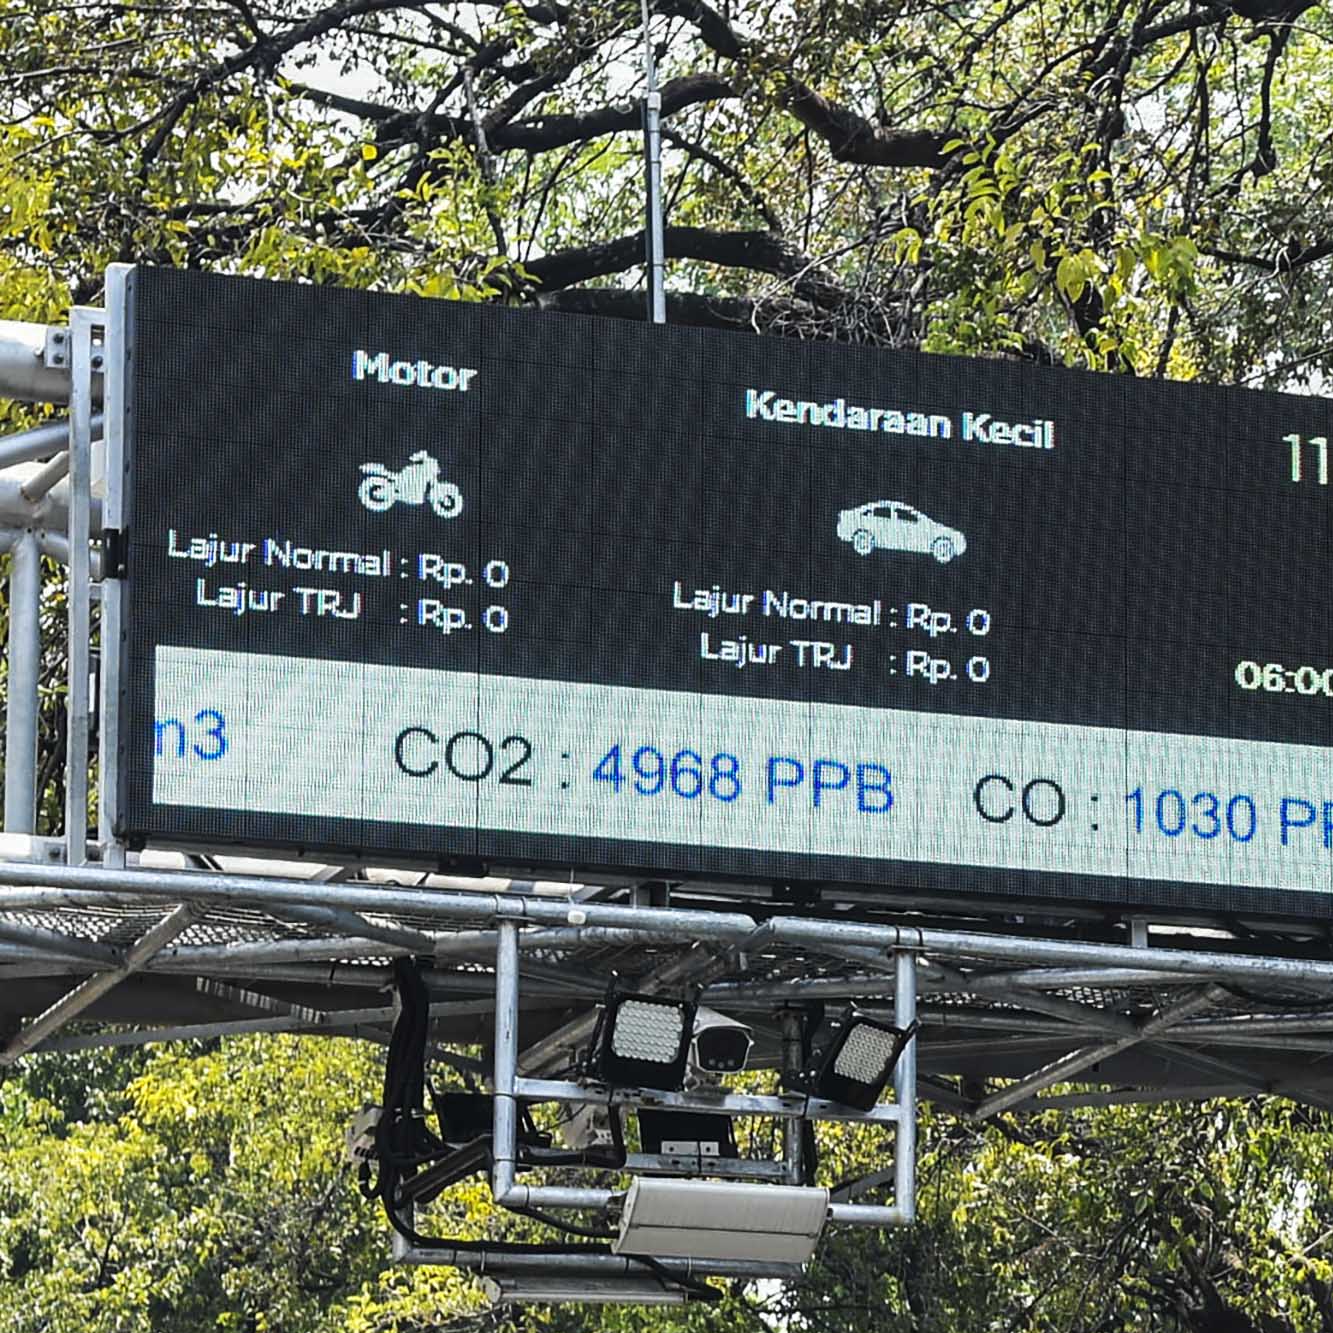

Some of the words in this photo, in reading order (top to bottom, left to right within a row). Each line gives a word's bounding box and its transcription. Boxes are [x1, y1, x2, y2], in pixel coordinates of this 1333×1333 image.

[352, 350, 477, 391] Motor
[746, 389, 952, 438] Kendaraan
[962, 412, 1054, 449] Kecil
[168, 529, 255, 567] Lajur
[263, 539, 390, 576] Normal
[418, 554, 473, 589] Rp.
[483, 560, 509, 588] 0
[197, 578, 284, 615] Lajur
[293, 587, 361, 619] TRJ
[417, 599, 472, 634] Rp.
[483, 605, 509, 633] 0
[673, 582, 754, 618] Lajur
[763, 590, 881, 625] Normal
[906, 603, 957, 637] Rp.
[966, 609, 991, 636] 0
[701, 632, 781, 668] Lajur
[790, 640, 852, 670] TRJ
[906, 650, 957, 684] Rp.
[966, 656, 990, 682] 0
[396, 728, 531, 785] CO2
[591, 744, 743, 804] 4968
[765, 755, 895, 814] PPB
[974, 775, 1065, 826] CO
[1127, 787, 1258, 844] 1030
